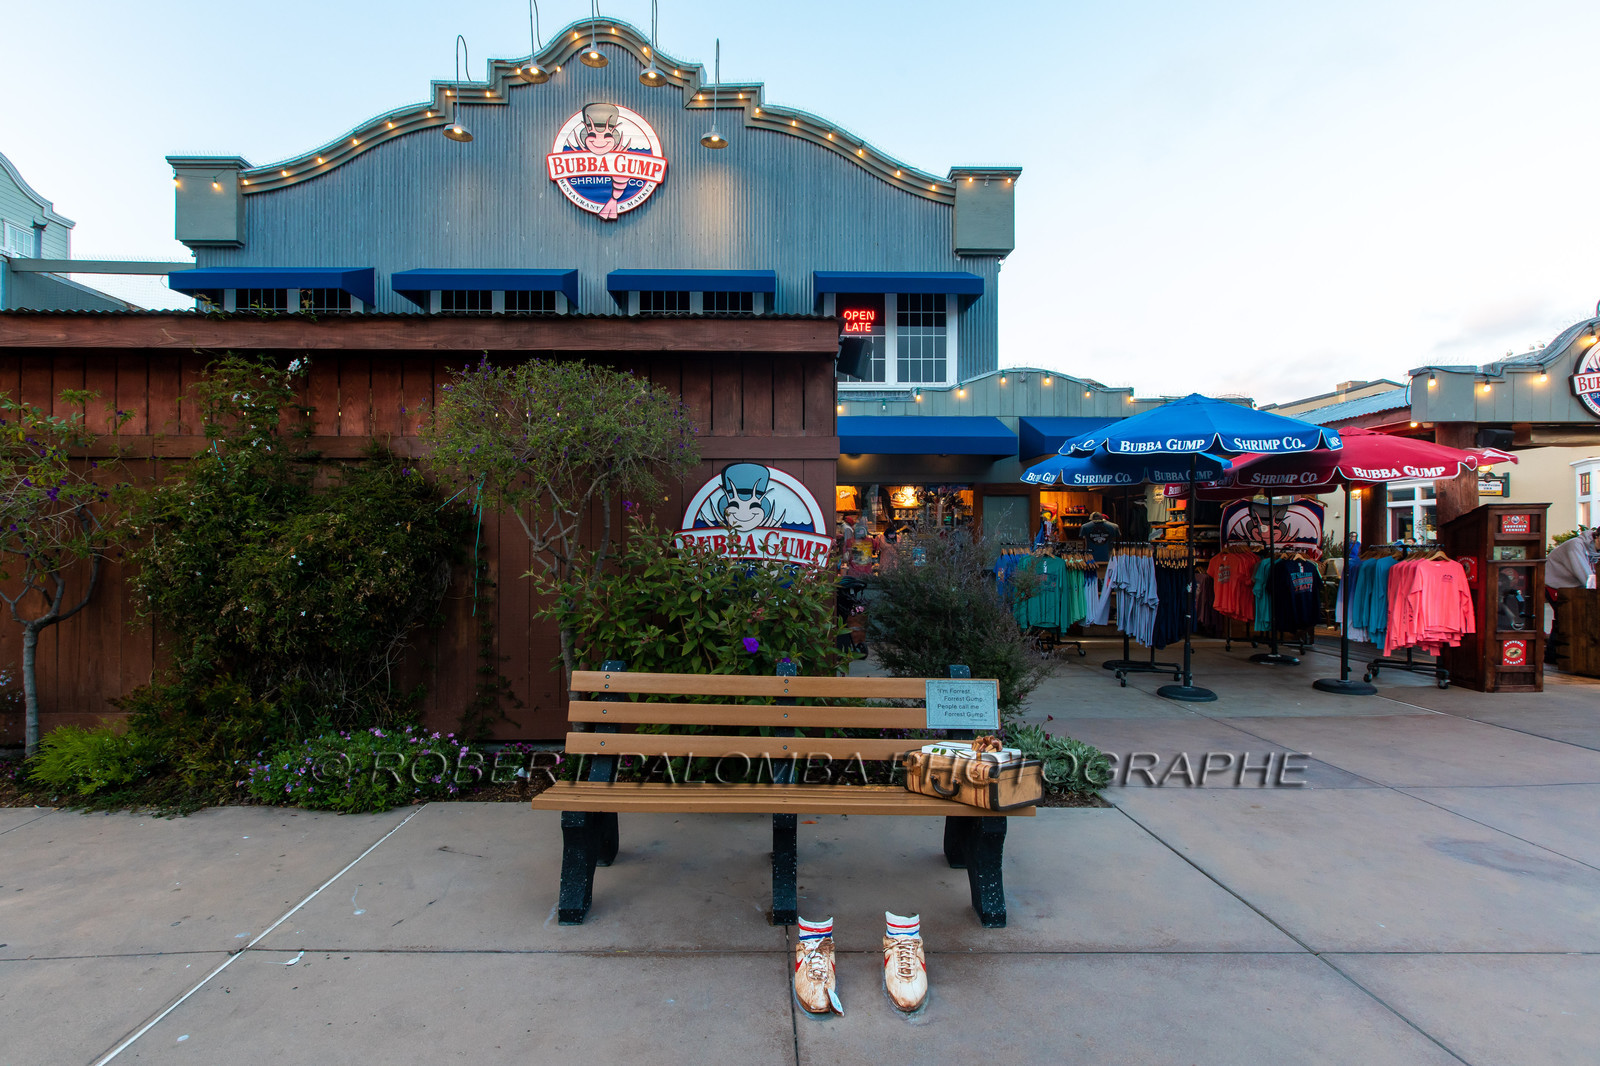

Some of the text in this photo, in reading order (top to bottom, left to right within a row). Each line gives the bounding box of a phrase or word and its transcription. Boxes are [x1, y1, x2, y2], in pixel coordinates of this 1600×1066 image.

[552, 155, 662, 178] BUBBA GUMP
[570, 177, 611, 185] SHRIMP
[560, 179, 600, 211] RESTAURANT
[627, 184, 653, 207] MARKET
[844, 310, 875, 321] OPEN
[846, 322, 872, 332] LATE
[1120, 438, 1205, 452] BUBBA GUMP
[1233, 436, 1306, 451] SHRIMP CO.
[1154, 470, 1185, 481] BUBBA
[1352, 465, 1446, 478] BUBBA GUMP
[1074, 473, 1113, 484] SHRIMP
[1250, 472, 1298, 484] SHRIMP
